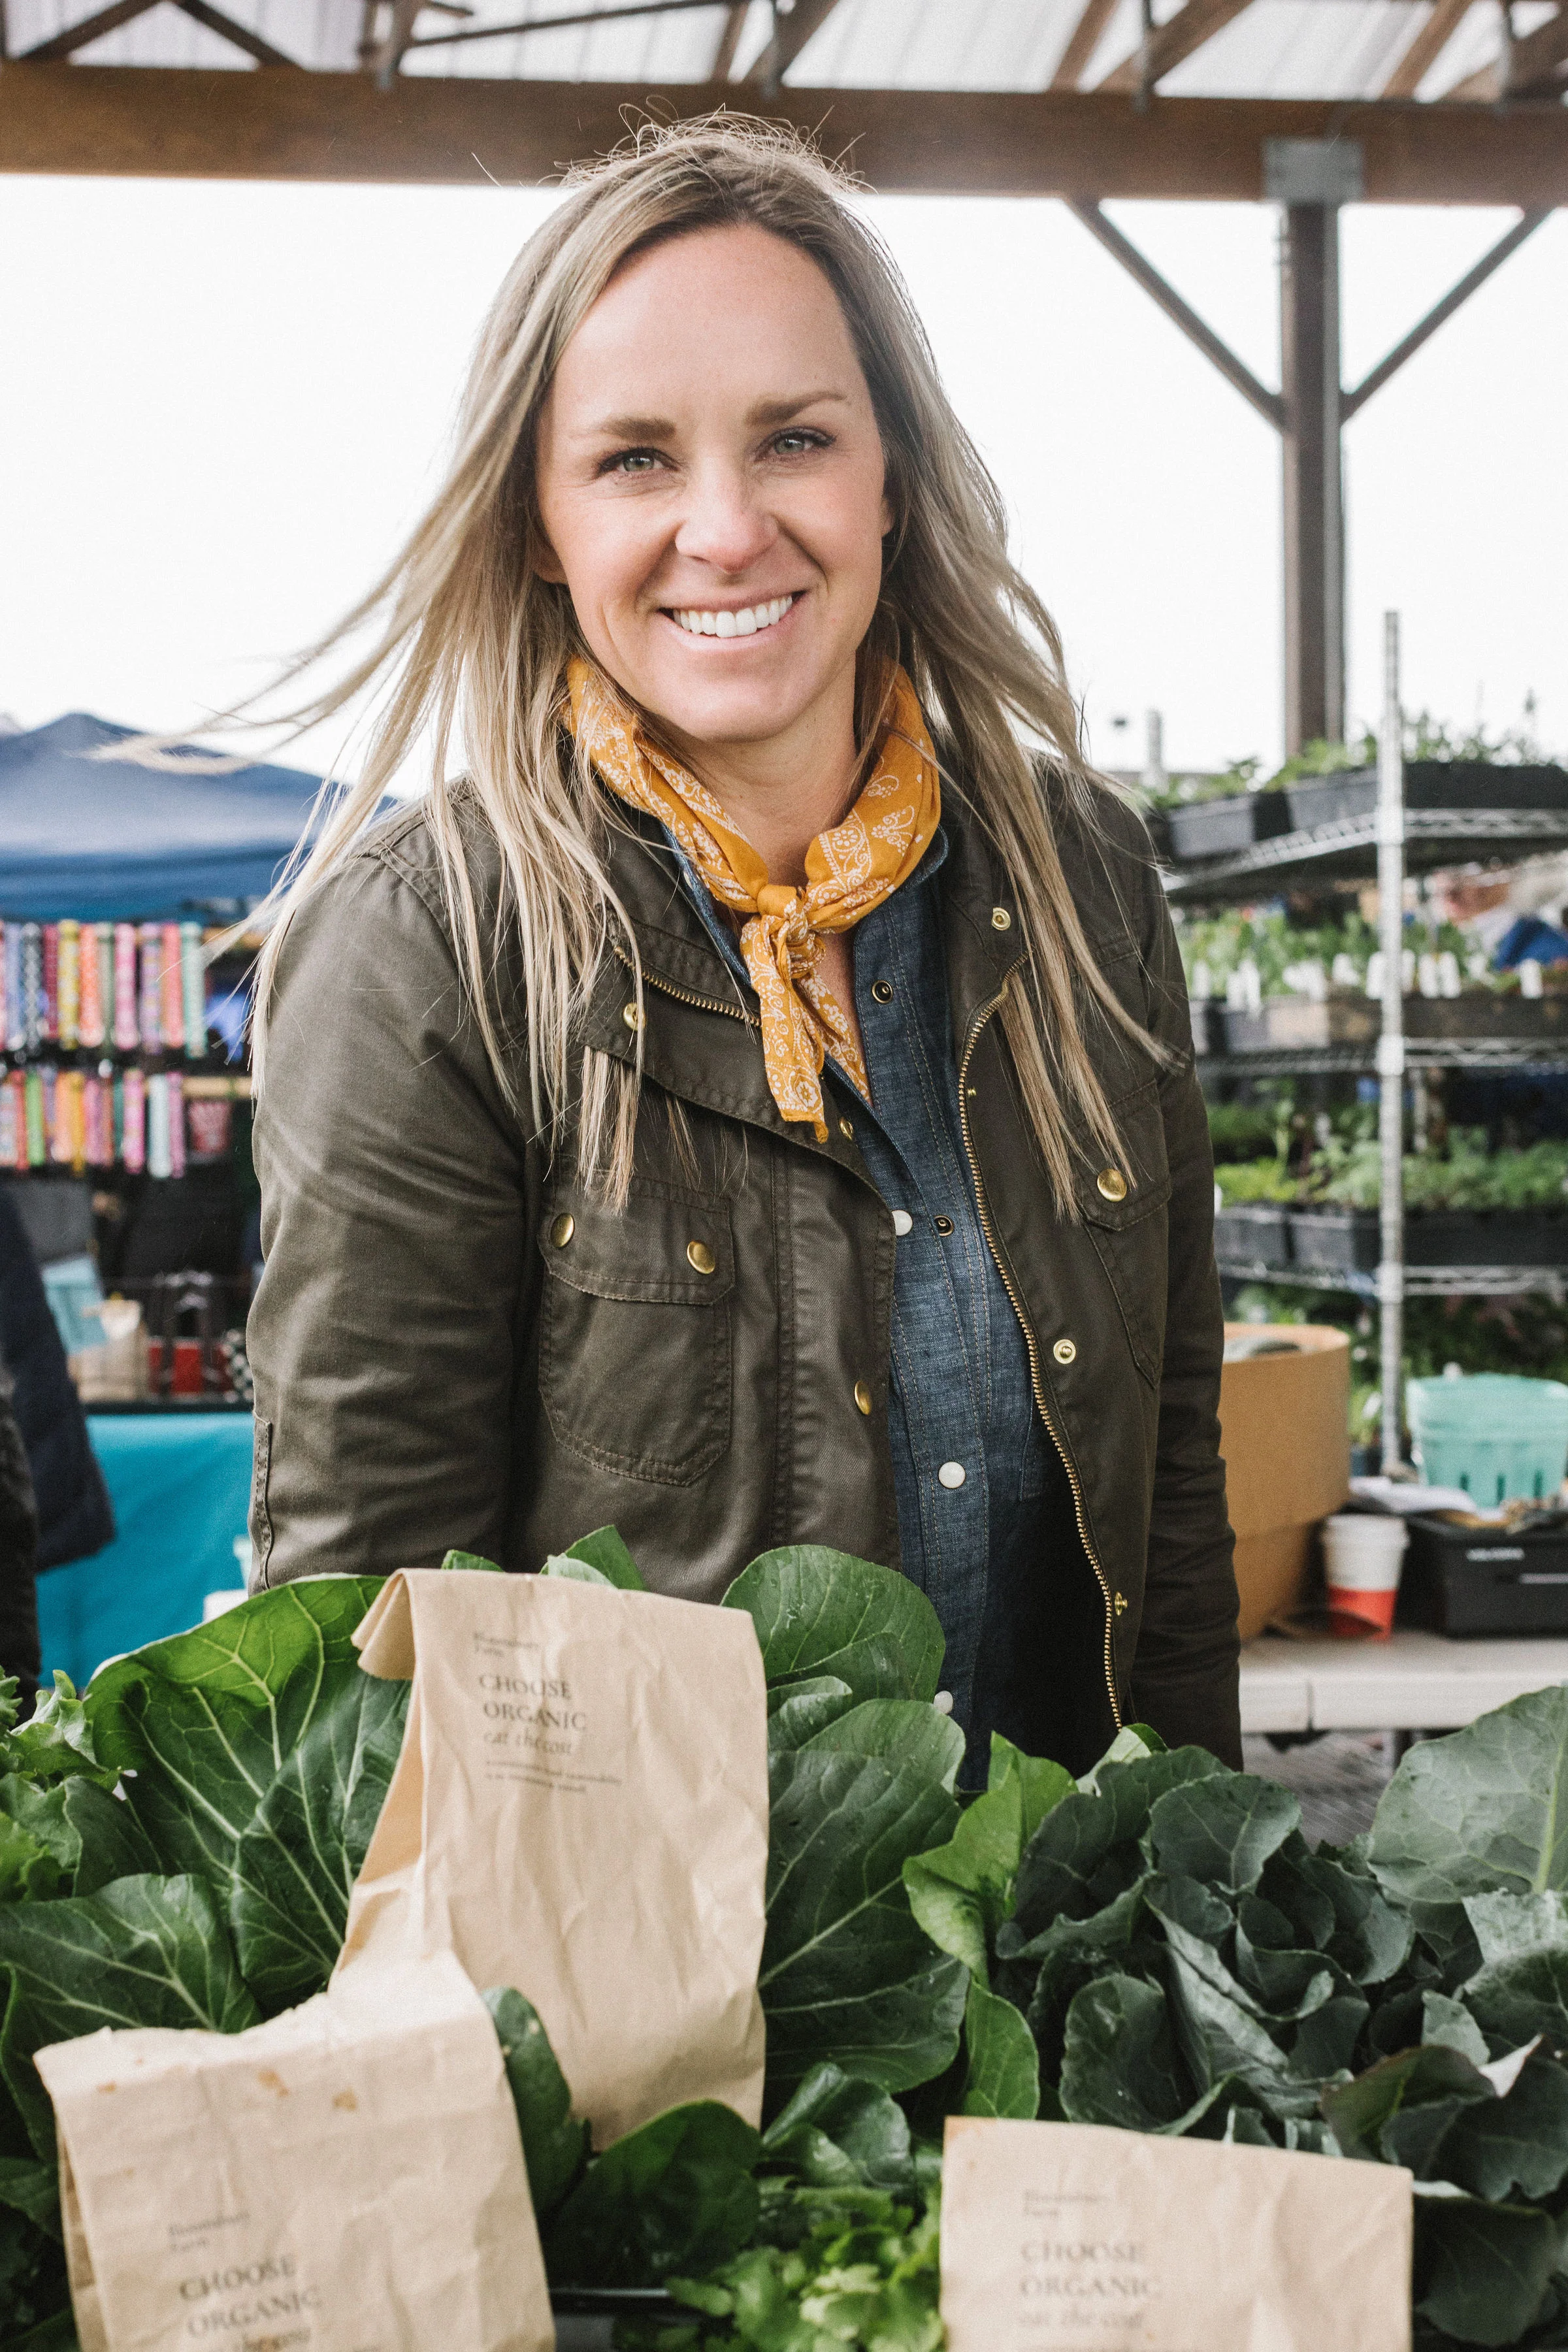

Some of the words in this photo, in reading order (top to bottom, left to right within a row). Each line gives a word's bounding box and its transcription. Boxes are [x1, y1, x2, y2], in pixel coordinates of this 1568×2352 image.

[479, 1673, 573, 1701] CHOOSE
[483, 1701, 588, 1732] ORGANIC
[1021, 2239, 1146, 2264] CHOOSE
[178, 2252, 297, 2302] CHOOSE
[1019, 2273, 1162, 2298] ORGANIC
[188, 2285, 323, 2338] ORGANIC
